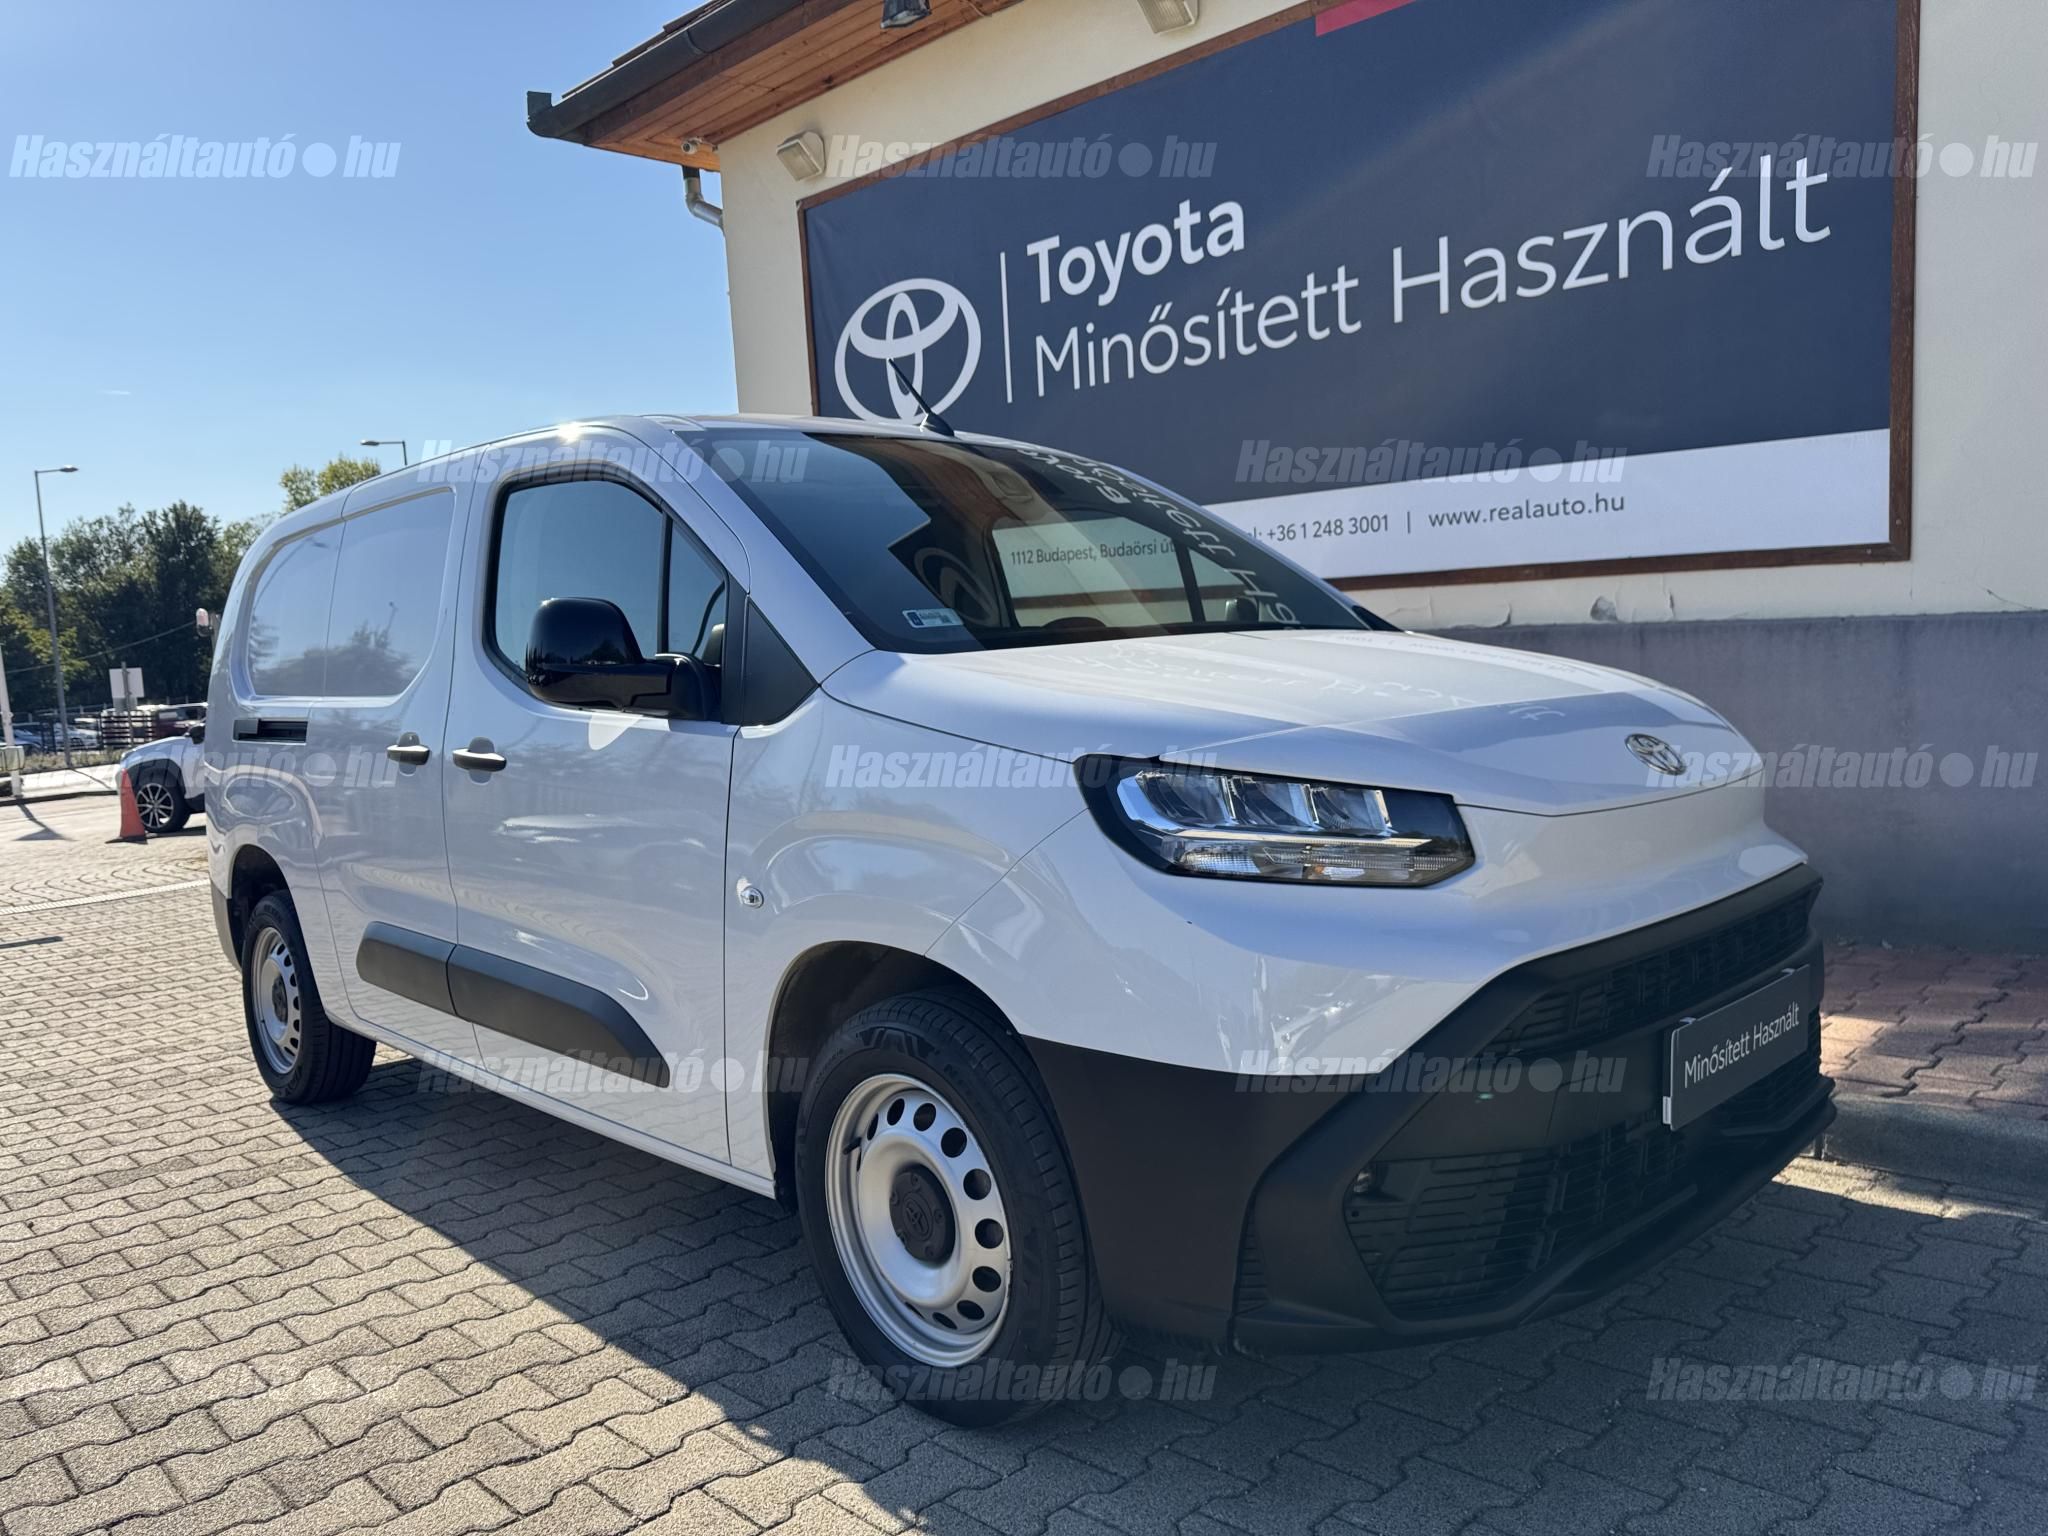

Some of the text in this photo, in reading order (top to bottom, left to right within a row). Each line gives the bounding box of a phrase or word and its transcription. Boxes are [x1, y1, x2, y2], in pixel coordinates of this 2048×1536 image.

[1027, 199, 1245, 306] Toyota
[1035, 154, 1831, 397] Minősített Használt
[1011, 550, 1033, 565] 1112
[1036, 546, 1097, 564] Budapest,
[1100, 539, 1157, 558] Budaörsi
[1267, 523, 1297, 541] +36
[1301, 521, 1307, 539] 1
[1312, 518, 1343, 538] 248
[1348, 514, 1388, 535] 3001
[1428, 493, 1625, 528] www.realauto.hu
[1684, 1001, 1800, 1088] Minősített Használt
